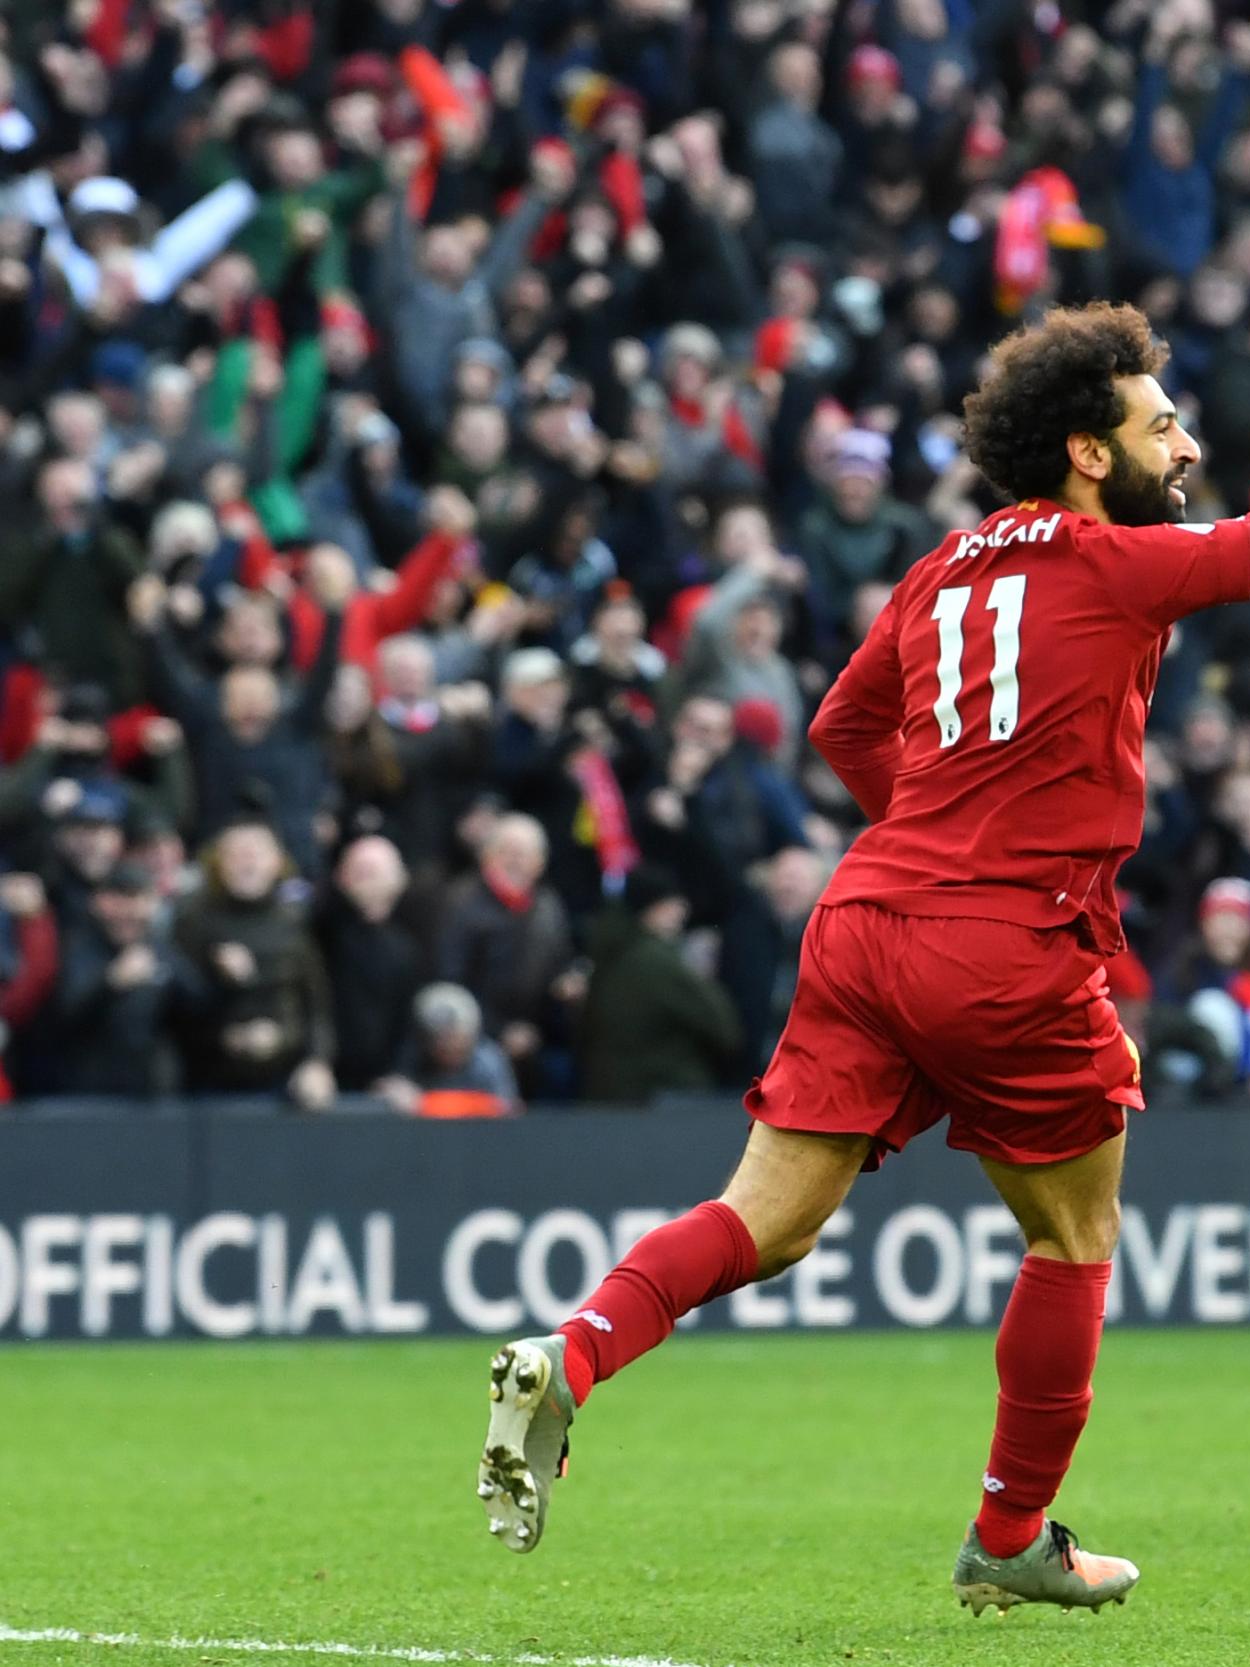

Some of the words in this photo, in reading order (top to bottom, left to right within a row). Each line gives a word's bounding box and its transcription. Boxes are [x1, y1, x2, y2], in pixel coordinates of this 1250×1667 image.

[931, 574, 1026, 748] 11
[0, 1210, 429, 1336] FFICIAL
[874, 1204, 1021, 1326] OF
